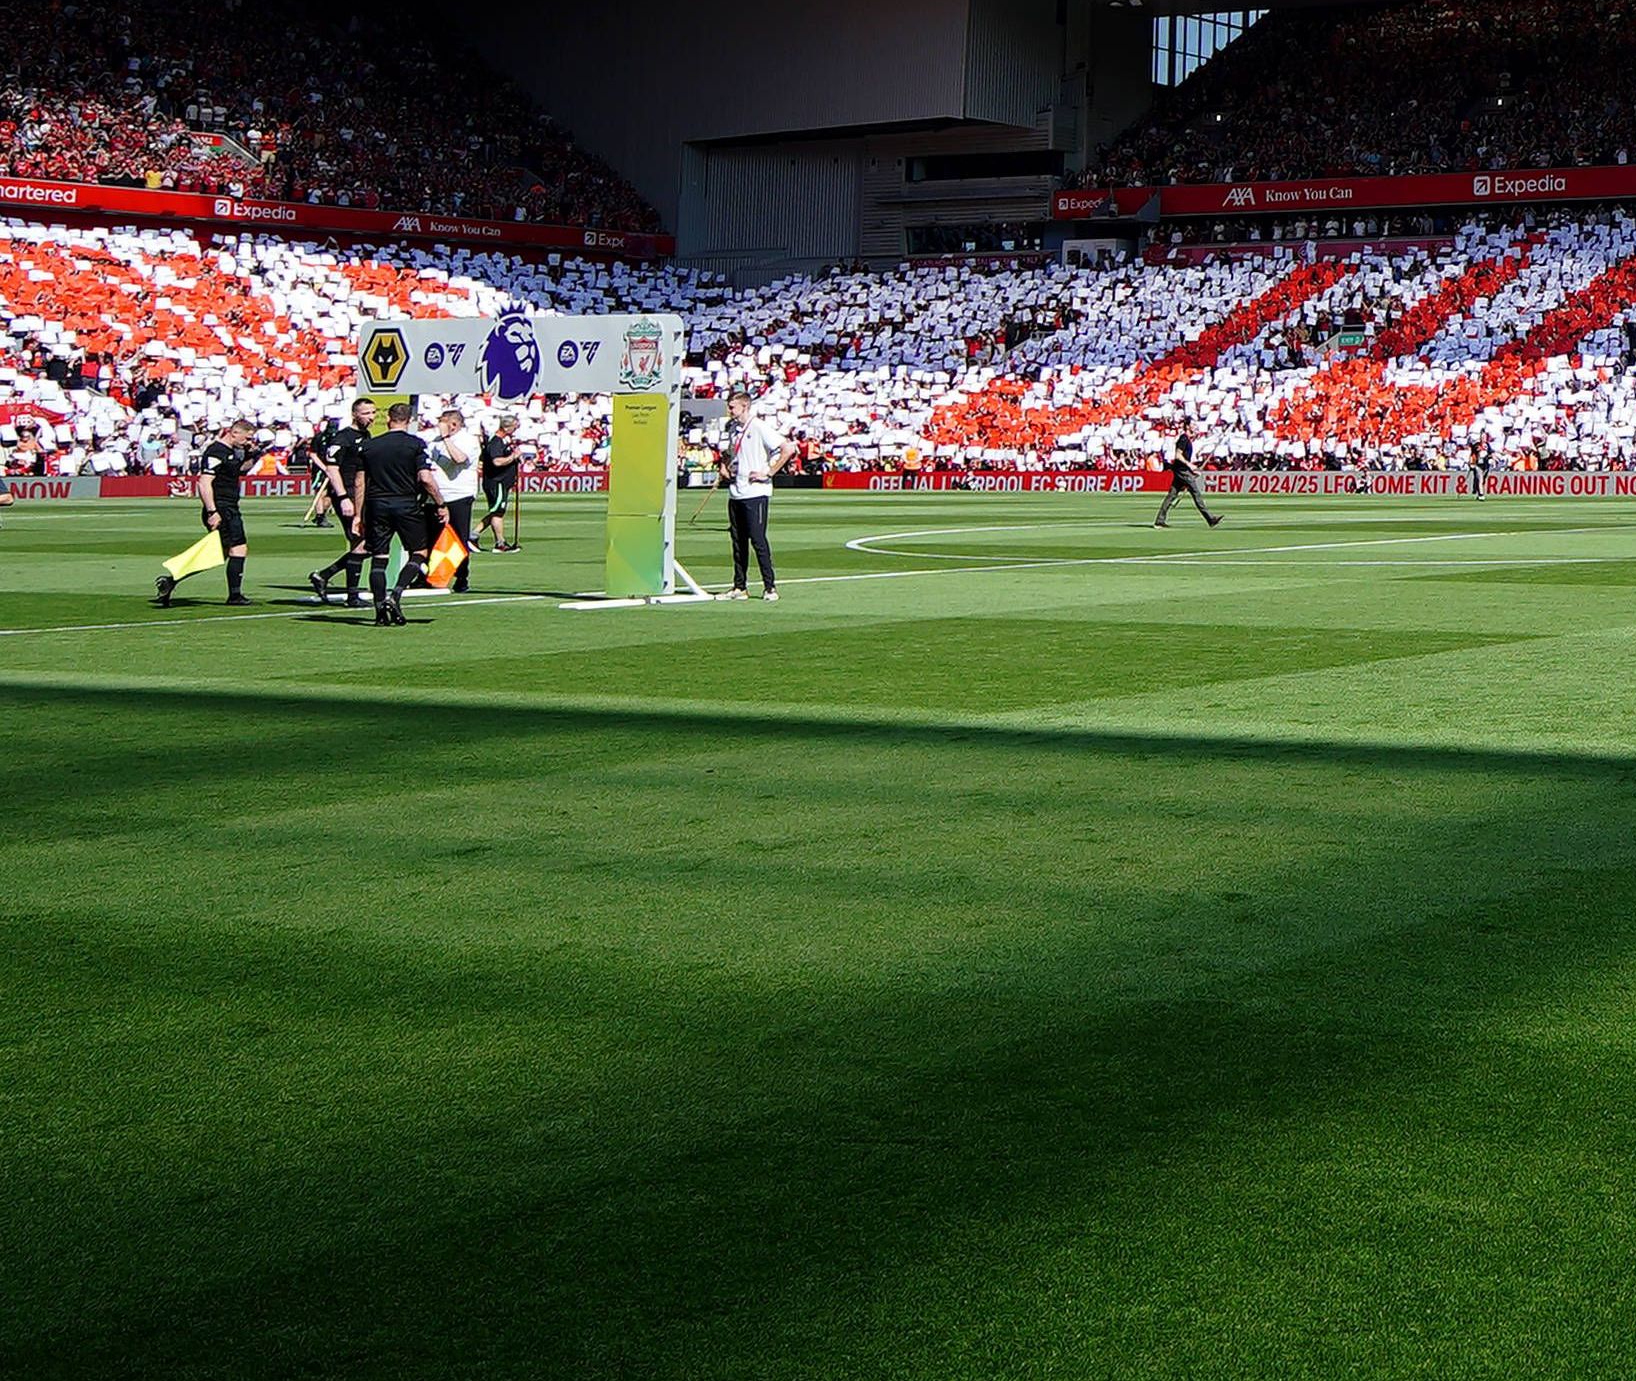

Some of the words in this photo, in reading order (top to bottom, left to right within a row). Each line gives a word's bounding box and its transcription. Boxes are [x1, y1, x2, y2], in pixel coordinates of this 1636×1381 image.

[1495, 176, 1566, 196] Expedia
[1223, 187, 1255, 206] AXA
[1265, 189, 1300, 201] Know
[1303, 188, 1328, 201] You
[1330, 186, 1353, 199] Can
[233, 202, 296, 221] Expedia
[392, 217, 421, 232] AXA
[430, 222, 460, 233] Know
[462, 224, 481, 236] You
[482, 226, 501, 236] Can
[10, 481, 71, 499] NOW
[252, 480, 292, 496] THE
[870, 476, 938, 491] OFFIIAL
[1032, 476, 1051, 491] FC
[1055, 476, 1106, 491] STORE
[1110, 476, 1144, 491] APP
[1204, 475, 1243, 493] NEW
[1248, 475, 1319, 494] 2024/25
[1375, 475, 1415, 494] OME
[1420, 475, 1450, 494] KIT
[1456, 475, 1468, 494] &
[1486, 475, 1564, 494] RAINING
[1570, 475, 1609, 495] OUT
